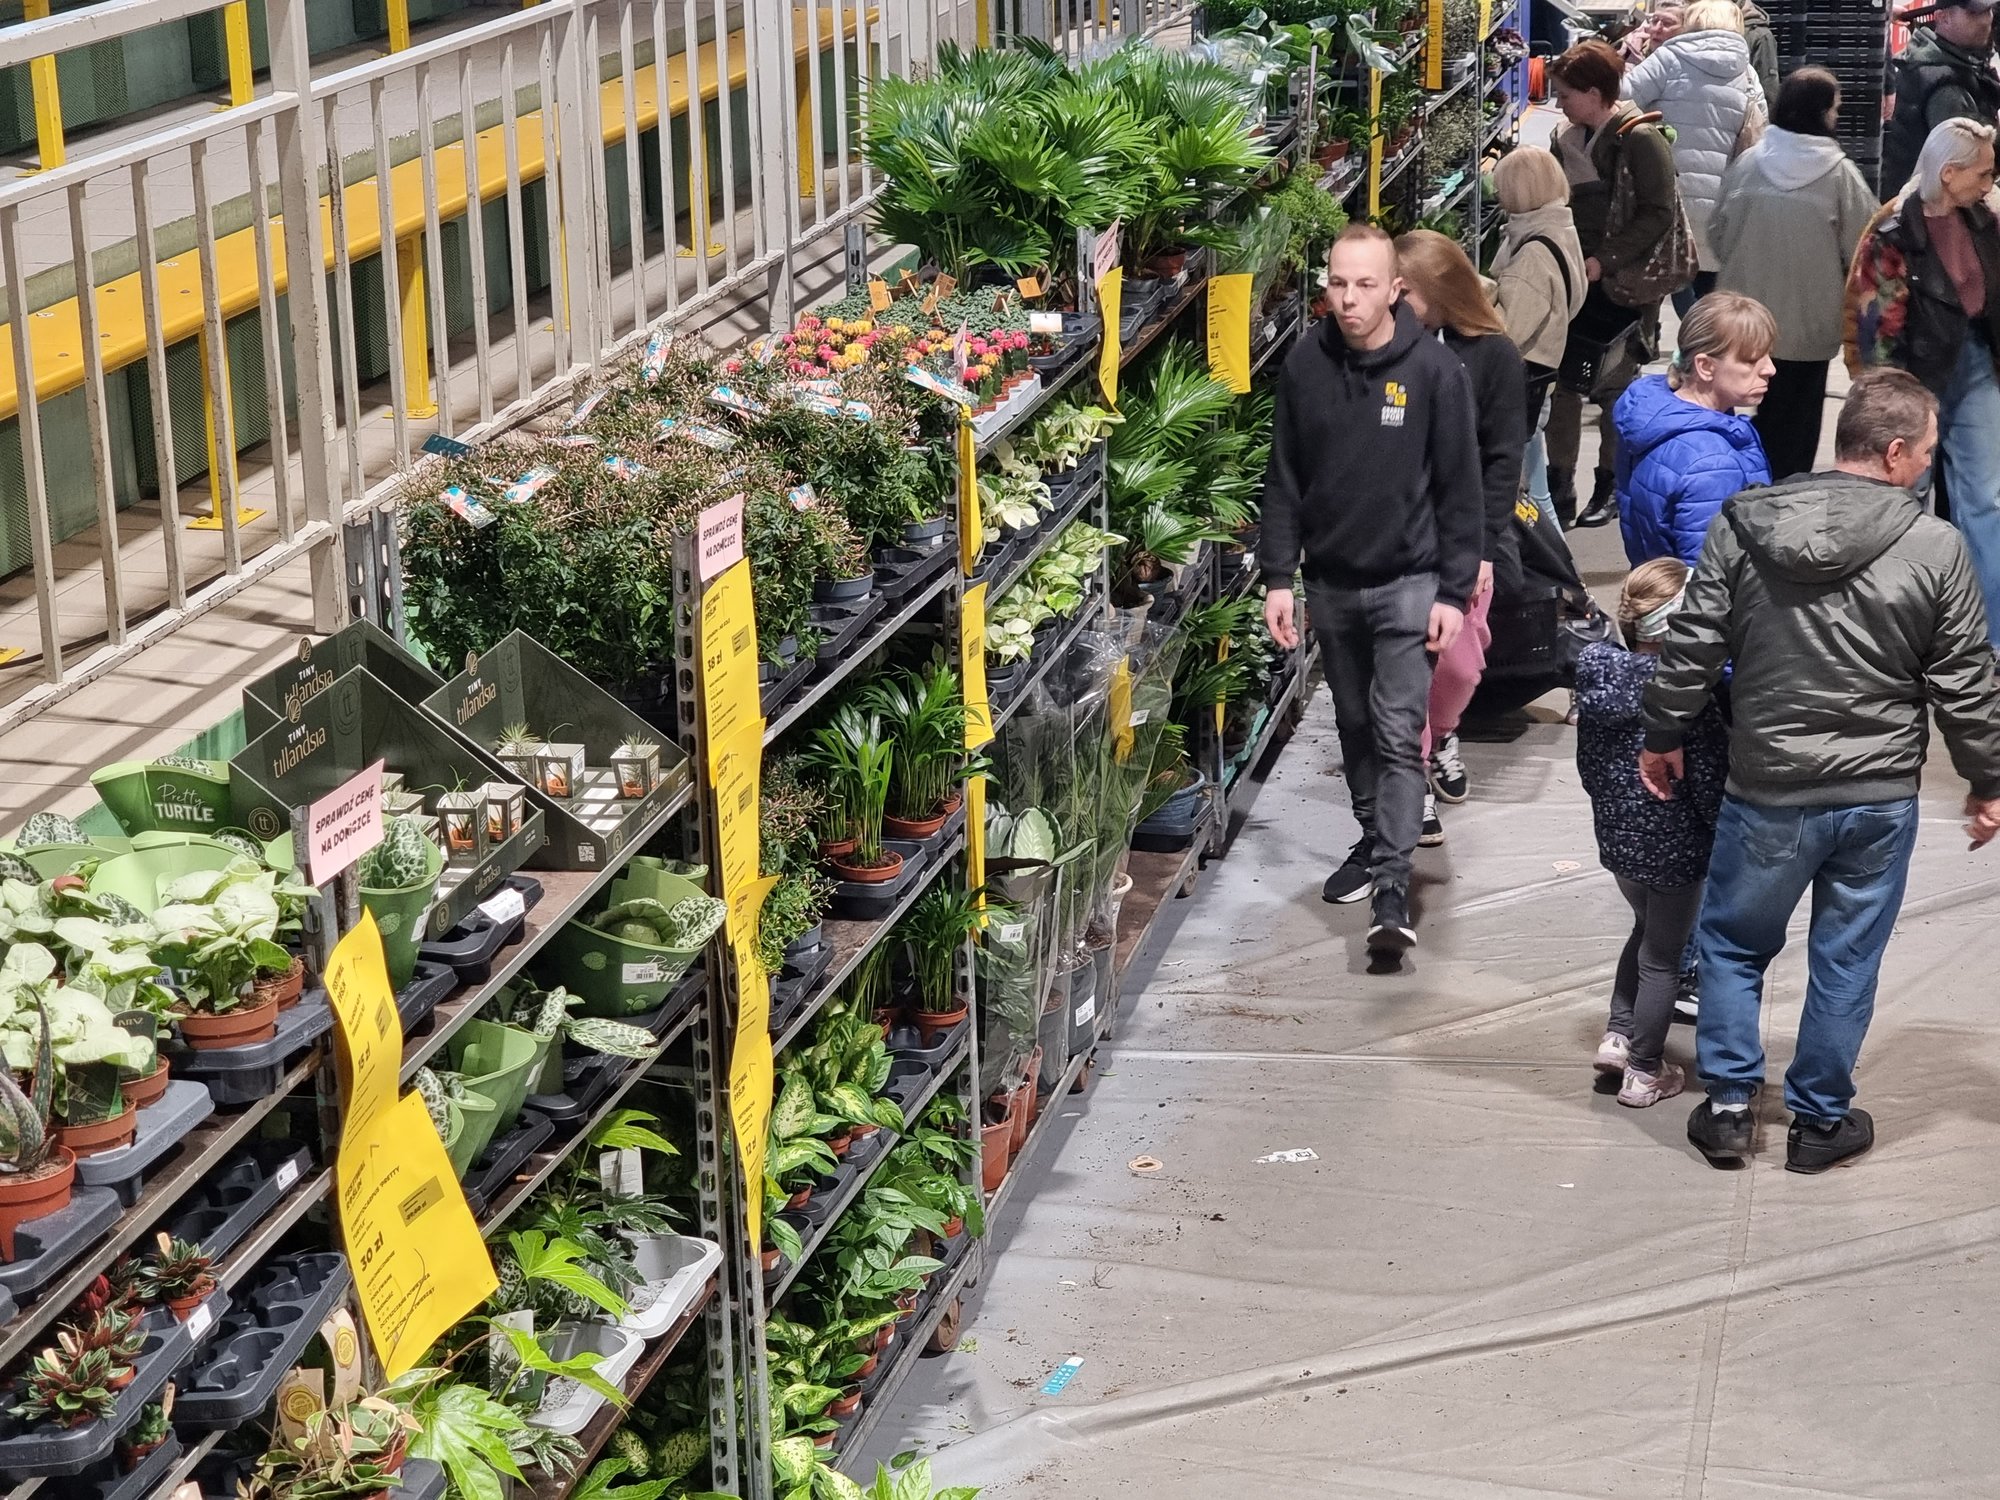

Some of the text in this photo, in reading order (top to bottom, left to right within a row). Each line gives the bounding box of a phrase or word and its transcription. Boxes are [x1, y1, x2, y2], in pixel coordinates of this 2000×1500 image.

[703, 513, 739, 541] SPRAWDŹ CENĘ
[705, 545, 713, 560] NA
[298, 664, 316, 680] TINY
[467, 678, 481, 693] TINY
[457, 682, 497, 726] tillandsia
[287, 724, 306, 744] TINY
[273, 727, 326, 779] tillandsia
[157, 783, 206, 808] Pretty
[154, 802, 215, 823] TURTLE
[315, 784, 375, 834] SPRAWDŹ CENĘ
[321, 810, 371, 856] NA DONICZCE
[358, 1053, 365, 1074] 15
[359, 1248, 373, 1273] 30
[373, 1231, 385, 1253] zł
